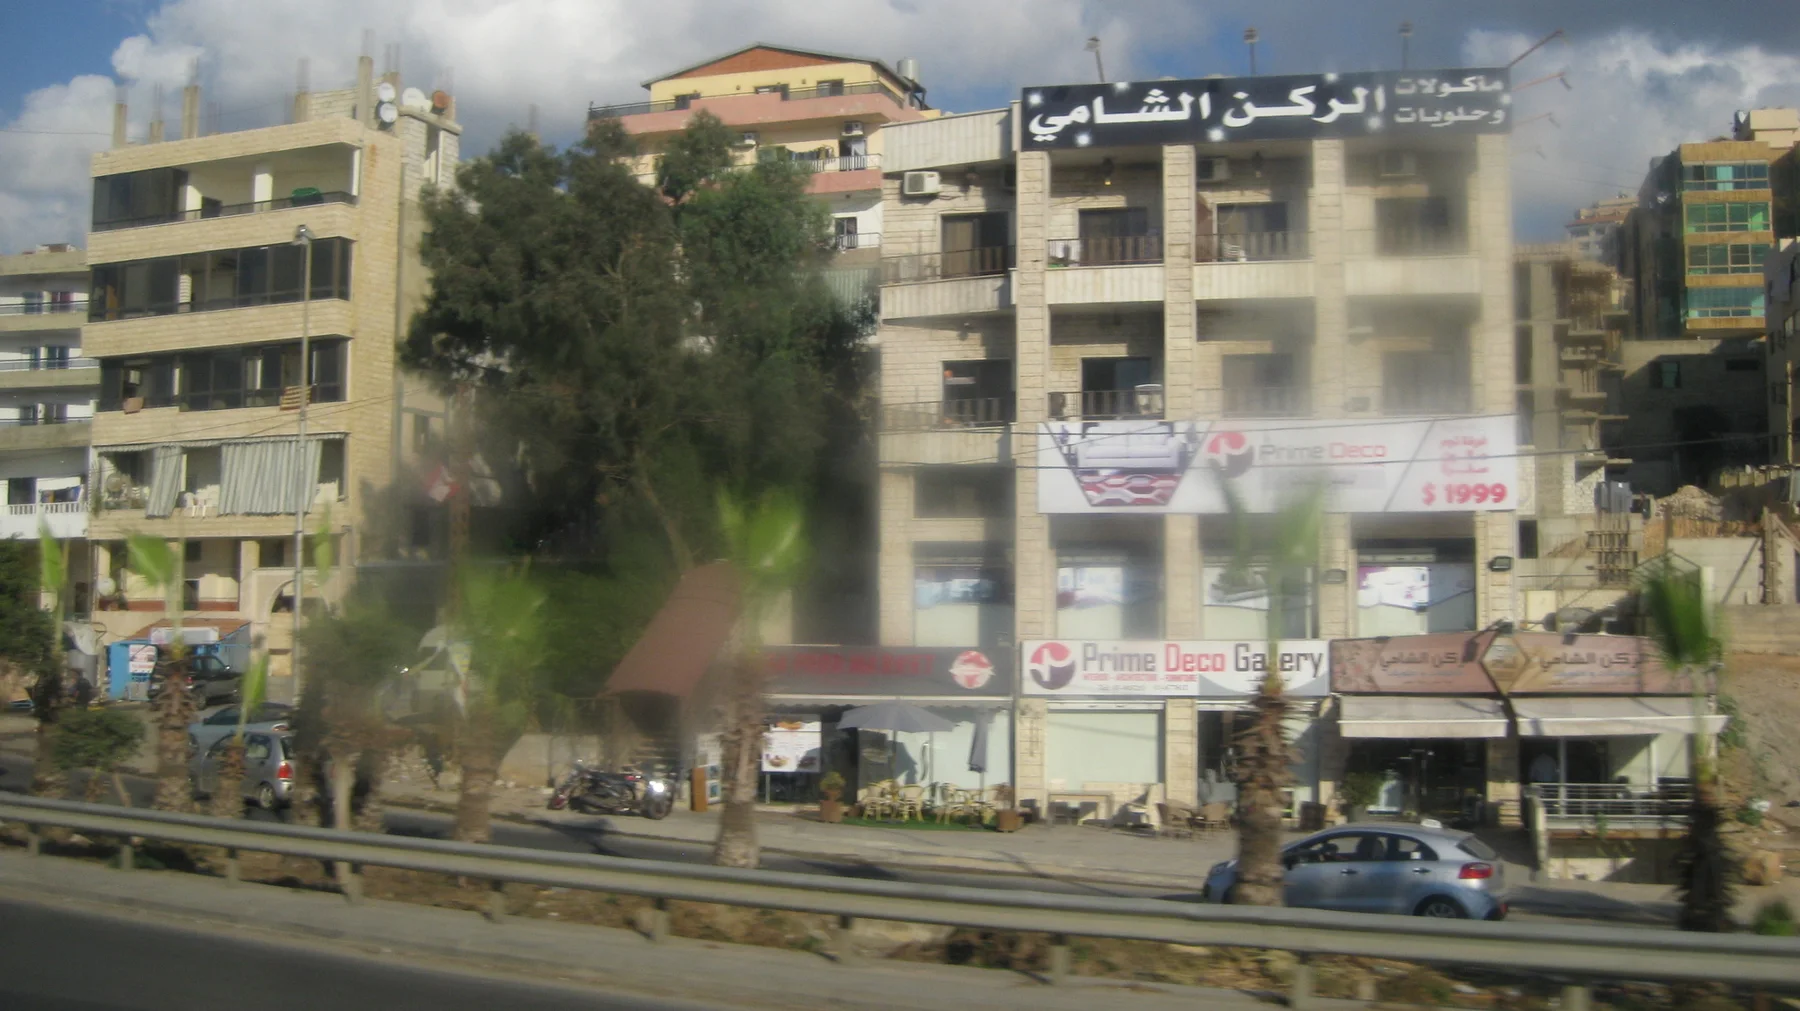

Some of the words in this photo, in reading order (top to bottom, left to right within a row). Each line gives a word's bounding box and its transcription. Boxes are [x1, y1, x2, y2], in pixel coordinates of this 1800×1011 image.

[1027, 89, 1211, 142] الشامي
[1221, 84, 1387, 128] الركن
[1394, 106, 1506, 127] وحلويات
[1259, 443, 1325, 460] Prime
[1329, 442, 1387, 459] Deco
[1444, 482, 1507, 504] 1999
[1082, 642, 1157, 673] Prime
[1164, 642, 1227, 673] Deco
[1234, 642, 1324, 678] Gaery
